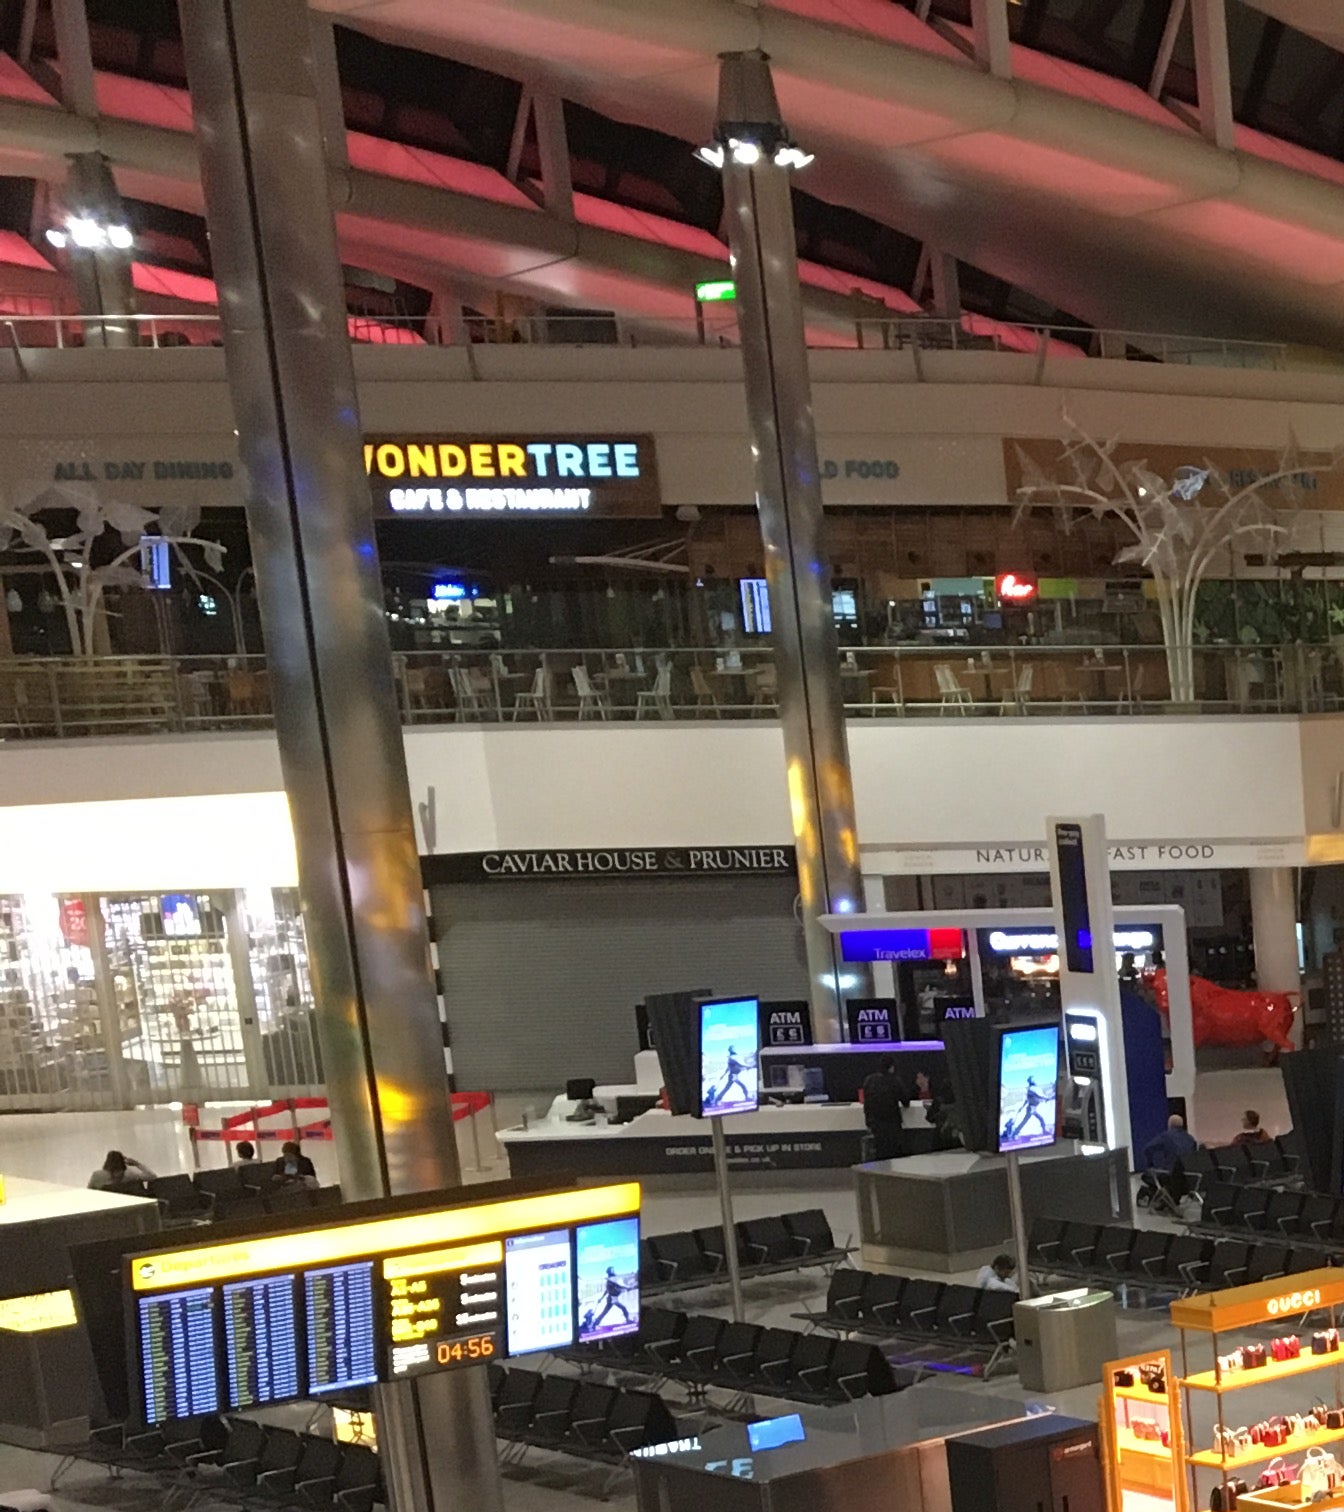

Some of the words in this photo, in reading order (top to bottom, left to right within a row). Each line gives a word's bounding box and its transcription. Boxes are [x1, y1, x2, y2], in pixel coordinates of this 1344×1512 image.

[54, 462, 97, 480] ALL
[104, 461, 146, 480] DAY
[845, 460, 900, 479] FOOD
[482, 852, 574, 874] CAVIAR
[577, 851, 657, 872] HOUSE
[664, 851, 685, 869] &
[689, 849, 789, 869] PRUNIER
[976, 848, 1050, 864] NATUR
[1158, 844, 1215, 859] FOOD
[873, 947, 927, 960] Travelex
[769, 1011, 801, 1025] ATM
[857, 1009, 889, 1022] ATM
[944, 1006, 976, 1019] ATM
[1267, 1289, 1321, 1315] GUCCI
[437, 1335, 494, 1365] 04:56
